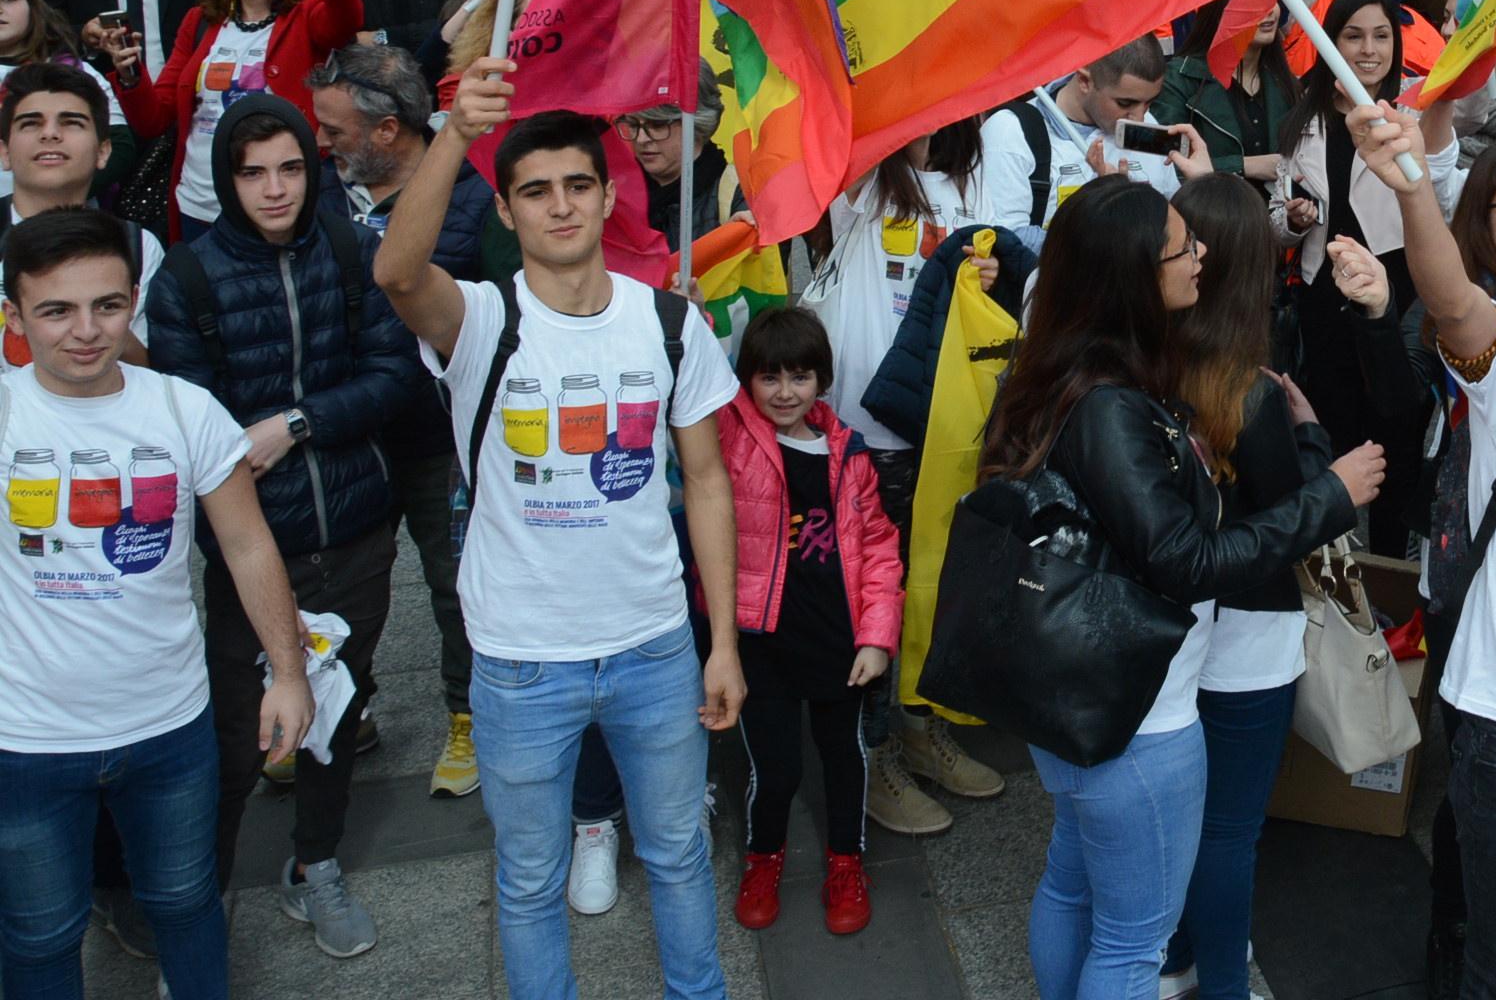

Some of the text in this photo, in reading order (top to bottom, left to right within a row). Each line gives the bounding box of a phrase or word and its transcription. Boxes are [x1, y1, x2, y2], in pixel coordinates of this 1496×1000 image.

[524, 499, 600, 509] OLBIA 21 MARZO 2017
[57, 572, 66, 581] 21
[67, 572, 96, 581] MARZO
[97, 573, 115, 582] 2017
